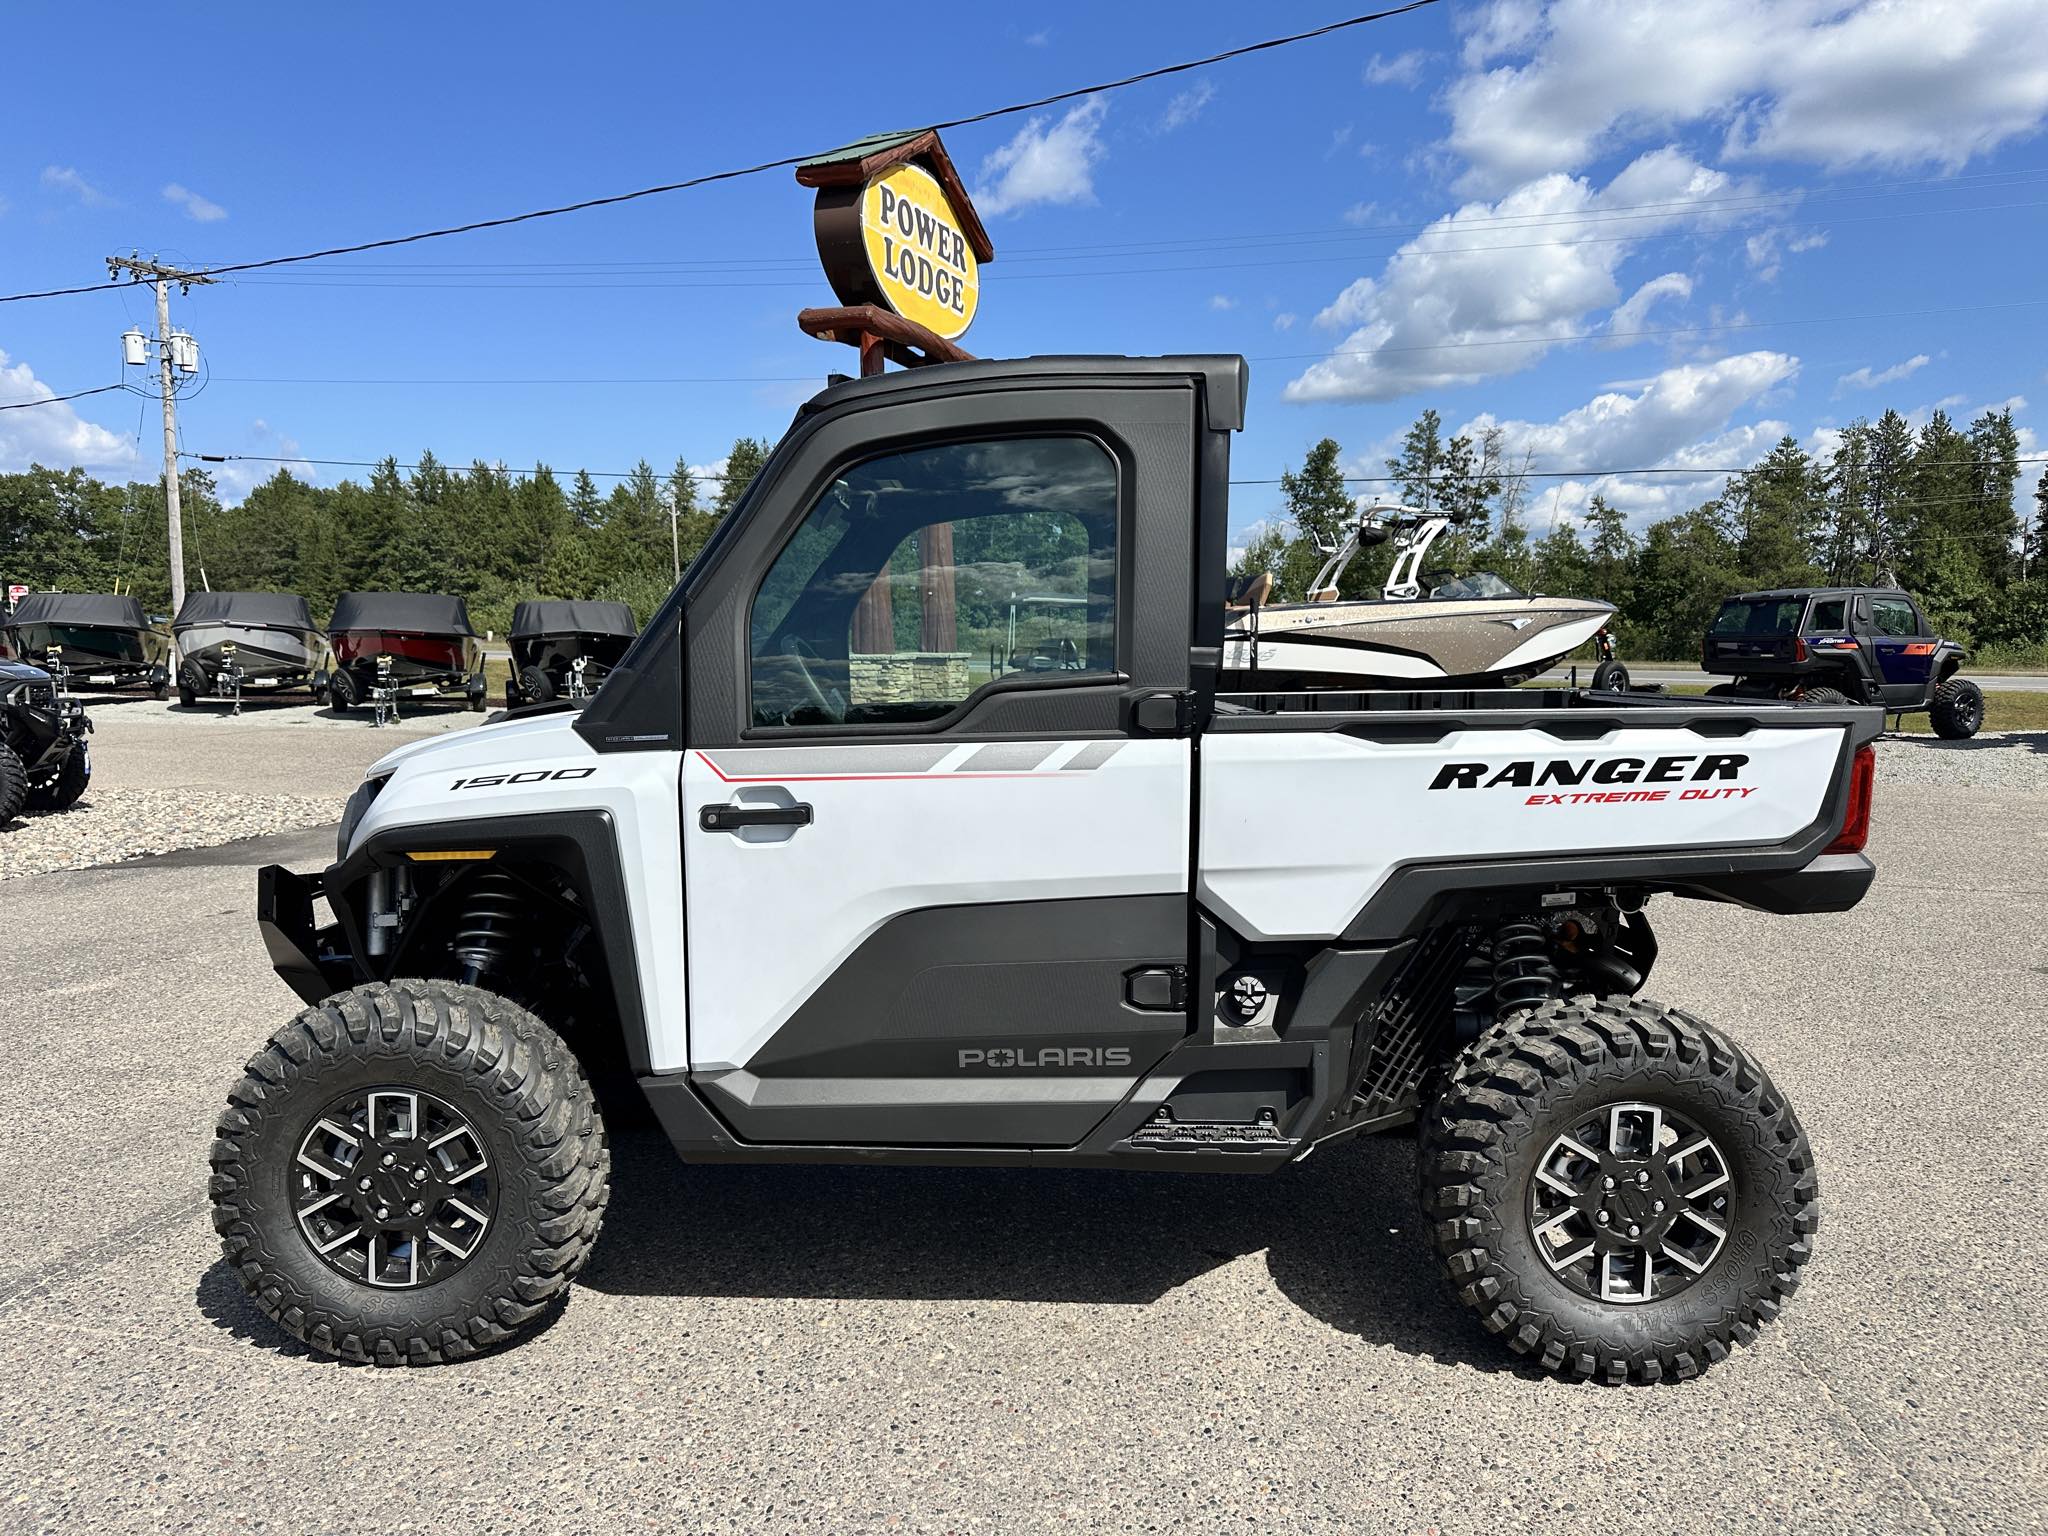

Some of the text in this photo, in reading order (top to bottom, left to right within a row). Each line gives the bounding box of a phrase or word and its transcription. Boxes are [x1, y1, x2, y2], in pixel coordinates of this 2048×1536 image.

[880, 184, 967, 274] POWER
[884, 236, 965, 314] LODGE
[449, 767, 598, 791] 1500
[1428, 754, 1750, 791] RANGER
[1524, 786, 1760, 806] EXTREME DUTY
[958, 1047, 1132, 1068] POLARIS
[1701, 1229, 1758, 1307] CROSS
[361, 1287, 449, 1315] CROSS
